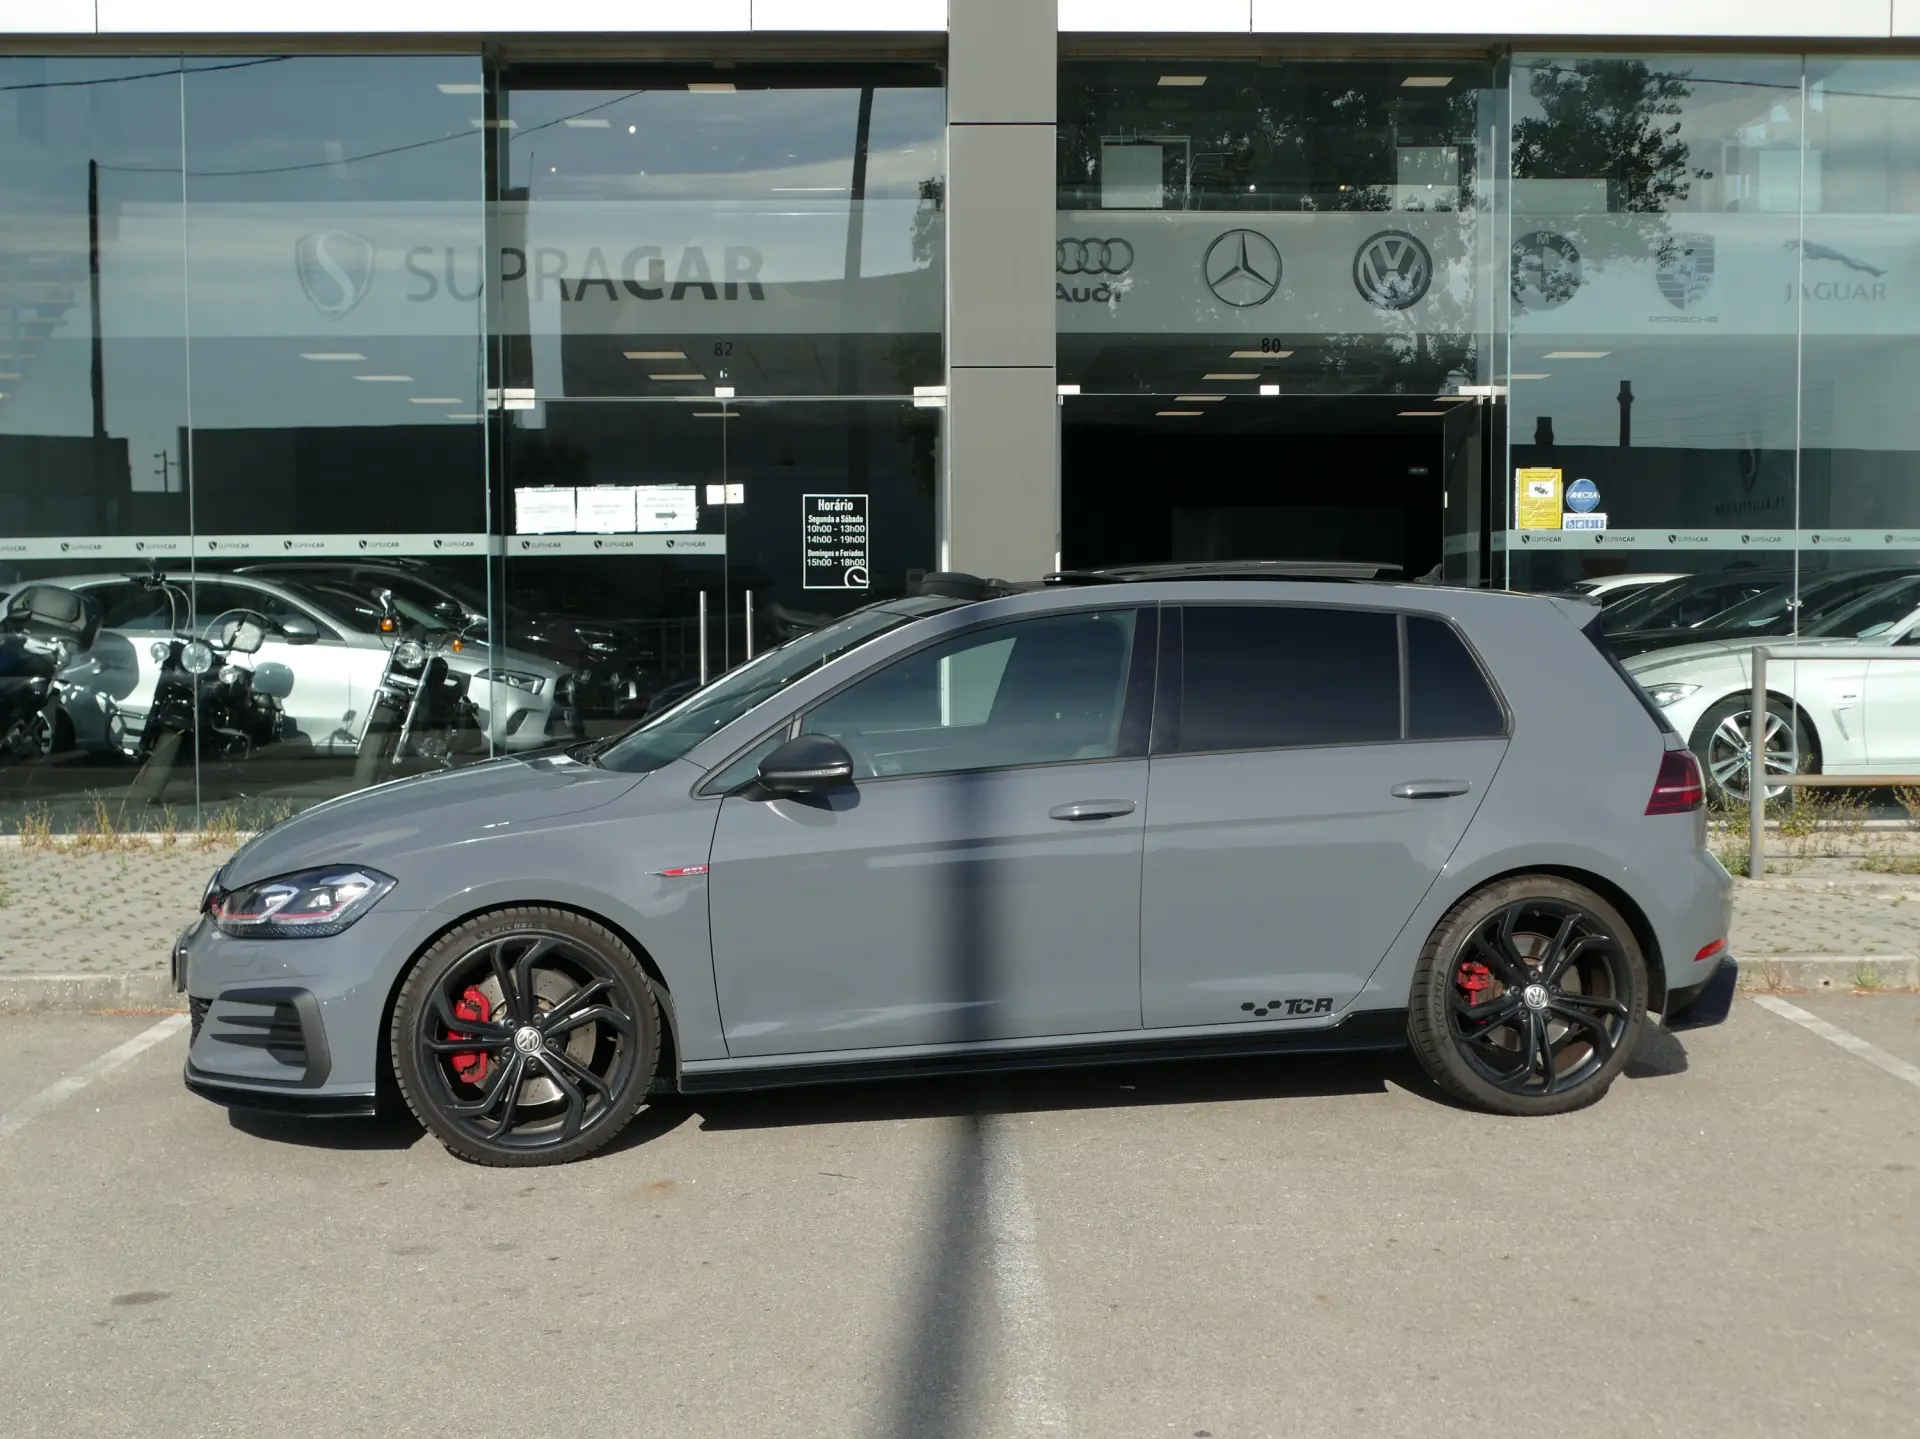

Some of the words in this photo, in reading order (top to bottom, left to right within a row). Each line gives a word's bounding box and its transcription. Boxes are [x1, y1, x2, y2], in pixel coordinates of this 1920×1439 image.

[405, 245, 765, 302] SUPRACAR
[1782, 282, 1887, 304] JAGUAR
[713, 341, 734, 357] 82
[1261, 337, 1281, 353] 80
[1569, 491, 1597, 499] ANECRA
[817, 498, 853, 511] Horário
[808, 514, 834, 525] Segunda
[840, 514, 864, 523] Sábado
[807, 525, 832, 533] 10h00
[840, 525, 865, 533] 13h00
[807, 535, 832, 543] 14h00
[840, 535, 865, 543] 19h00
[807, 549, 834, 558] Domingos
[840, 549, 864, 557] Feriados
[807, 558, 832, 566] 15h00
[840, 558, 865, 566] 18h00
[1284, 997, 1334, 1015] TCR
